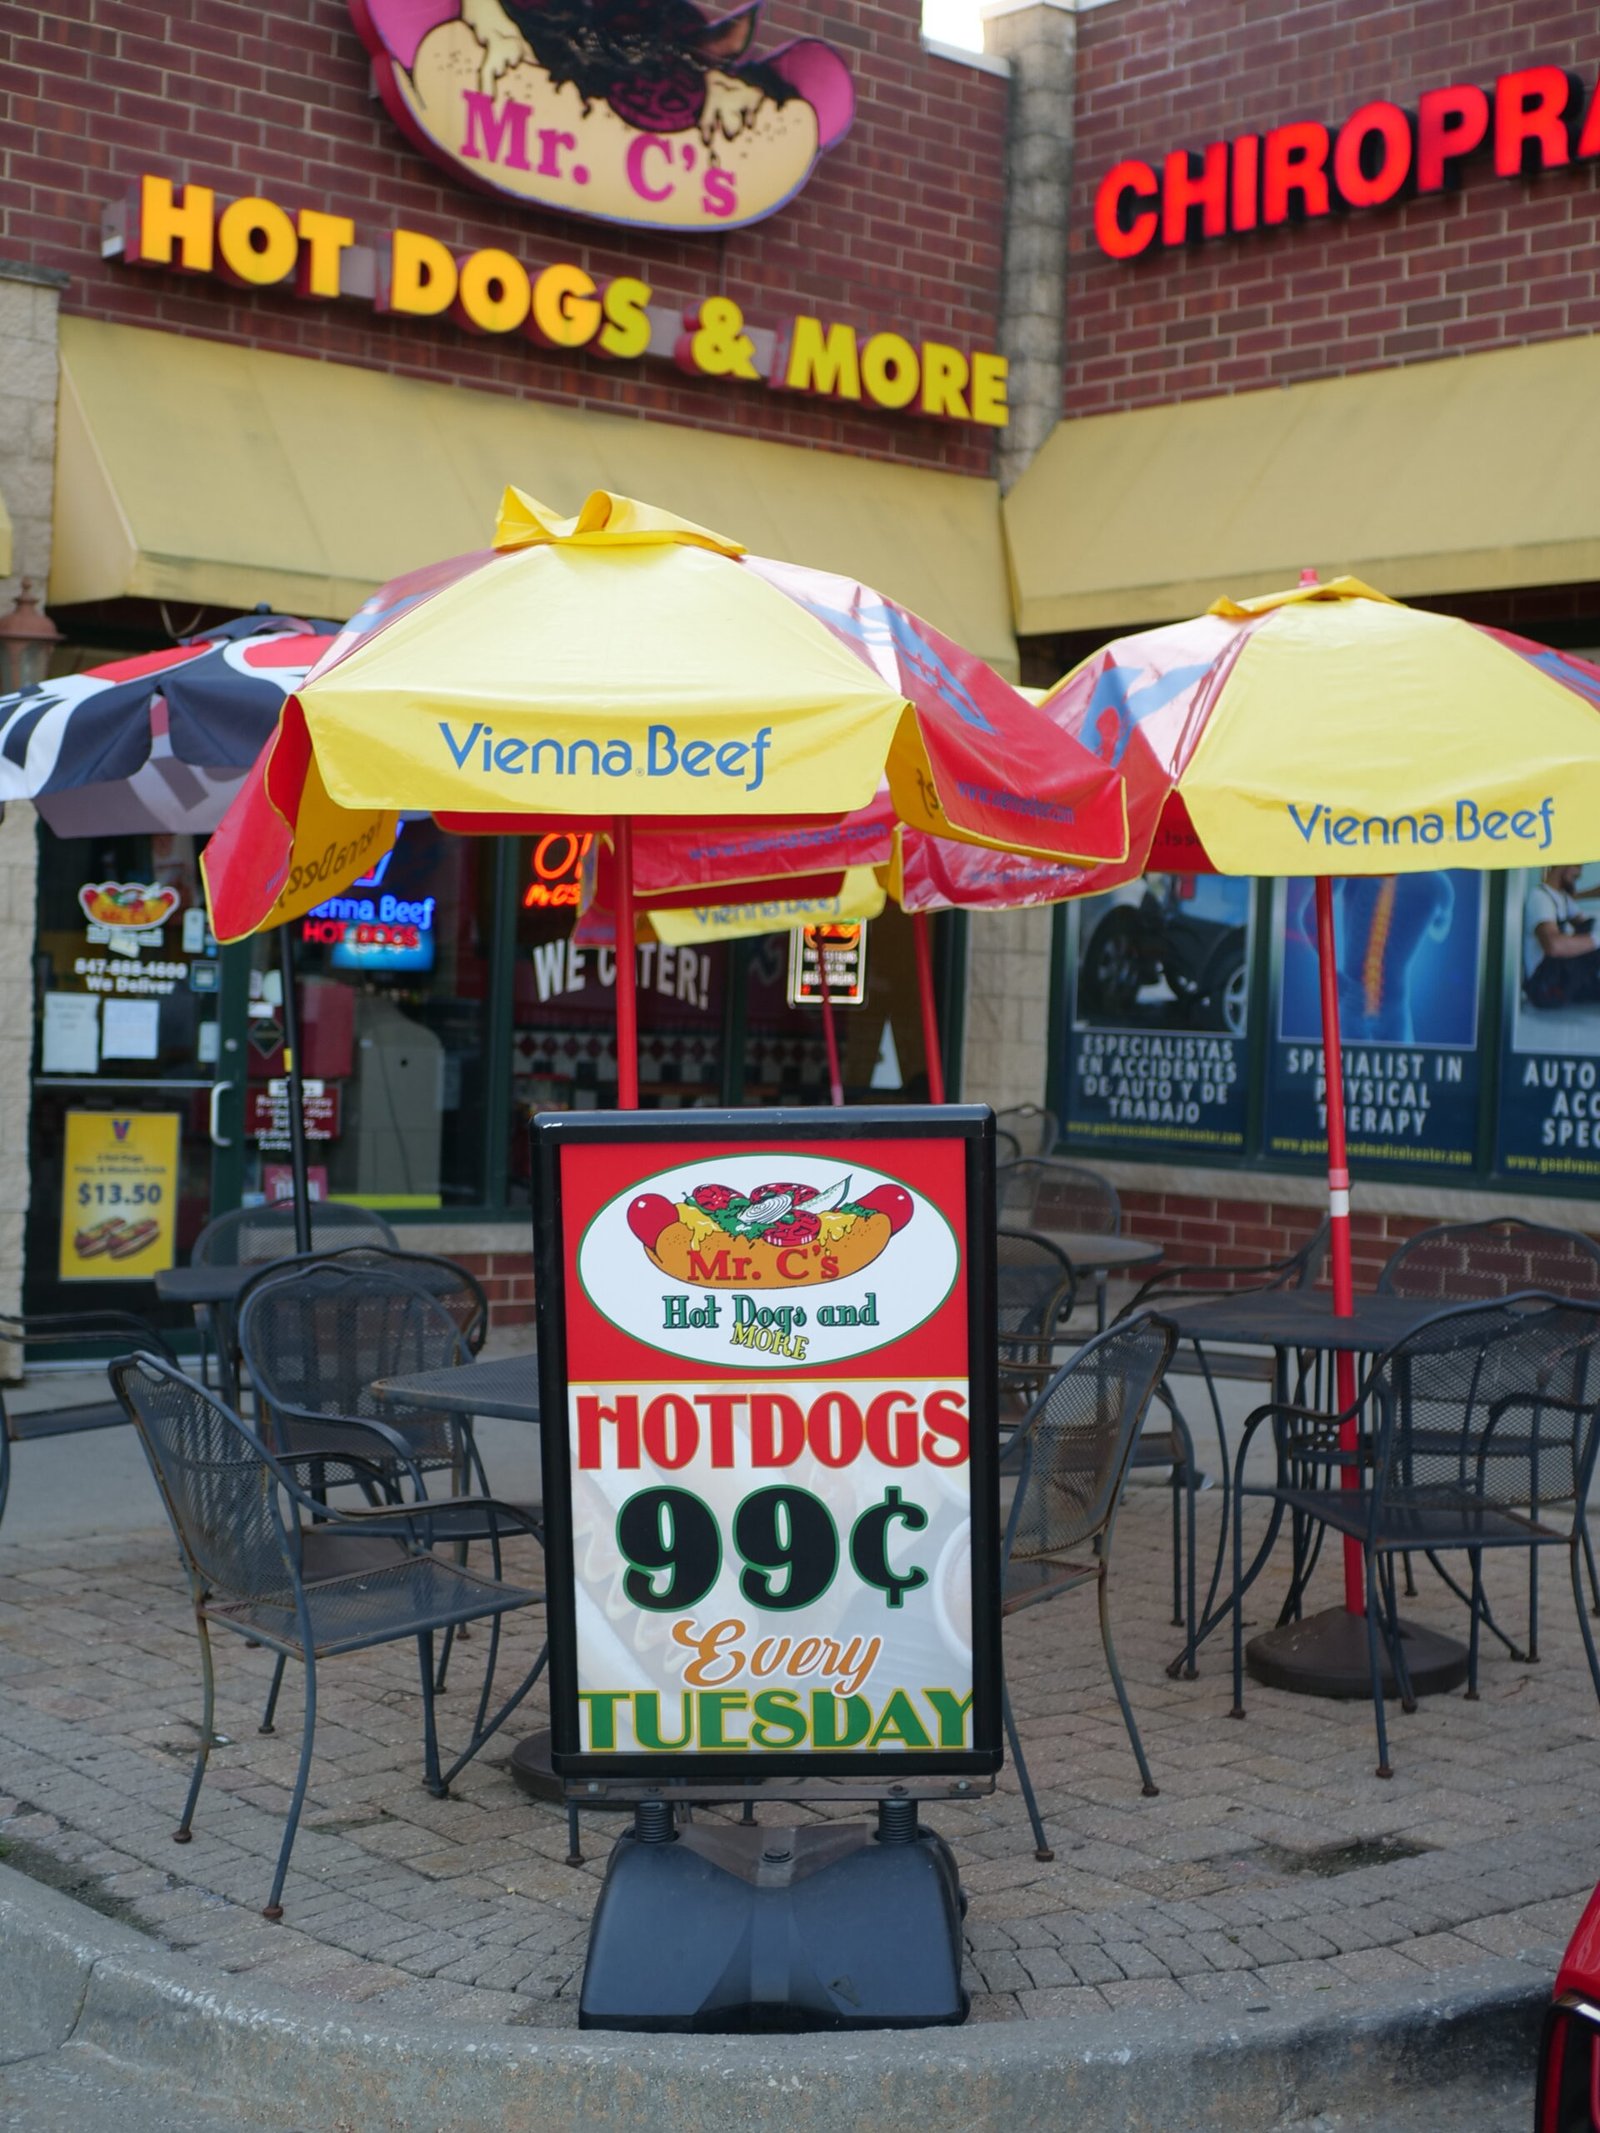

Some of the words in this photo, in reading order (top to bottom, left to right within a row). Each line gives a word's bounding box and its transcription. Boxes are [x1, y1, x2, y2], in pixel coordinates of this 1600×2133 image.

[460, 90, 590, 186] Mr.
[626, 135, 738, 218] C's
[140, 174, 355, 298] HOT
[391, 228, 652, 359] DOGS
[691, 296, 761, 380] &
[786, 315, 1009, 428] MORE
[438, 721, 633, 776] Vienna
[646, 724, 773, 792] Beef
[1287, 803, 1445, 848] Vienna
[1455, 797, 1556, 850] Beef
[379, 894, 436, 931] Beef
[302, 919, 349, 945] HOT
[356, 922, 419, 949] DOGS
[85, 975, 114, 992] We
[115, 976, 176, 995] Deliver
[532, 937, 587, 1003] WE
[596, 941, 711, 1011] CTER!
[1082, 1033, 1234, 1062] ESPECIALISTAS
[1286, 1047, 1425, 1081] SPEIALIST
[1435, 1055, 1463, 1083] IN
[1076, 1055, 1103, 1076] EN
[1110, 1056, 1238, 1084] ACCIDENTES
[1523, 1058, 1597, 1090] AUTO
[1083, 1074, 1110, 1097] DE
[1116, 1077, 1173, 1101] AUTO
[1181, 1081, 1194, 1102] Y
[1201, 1082, 1228, 1105] DE
[1314, 1077, 1431, 1110] PYSICAL
[1108, 1096, 1201, 1124] TRABAJO
[1316, 1104, 1426, 1137] TERAPY
[77, 1181, 163, 1207] $13.50
[686, 1249, 763, 1282] Mr.
[775, 1243, 841, 1281] C's
[661, 1293, 720, 1330] Hot
[732, 1294, 807, 1338] Dogs
[816, 1291, 880, 1328] and
[730, 1321, 811, 1362] MORE
[575, 1388, 971, 1470] HOTDOGS
[615, 1484, 930, 1613] 99¢
[671, 1617, 883, 1697] Every
[579, 1688, 975, 1753] TUESDAY
